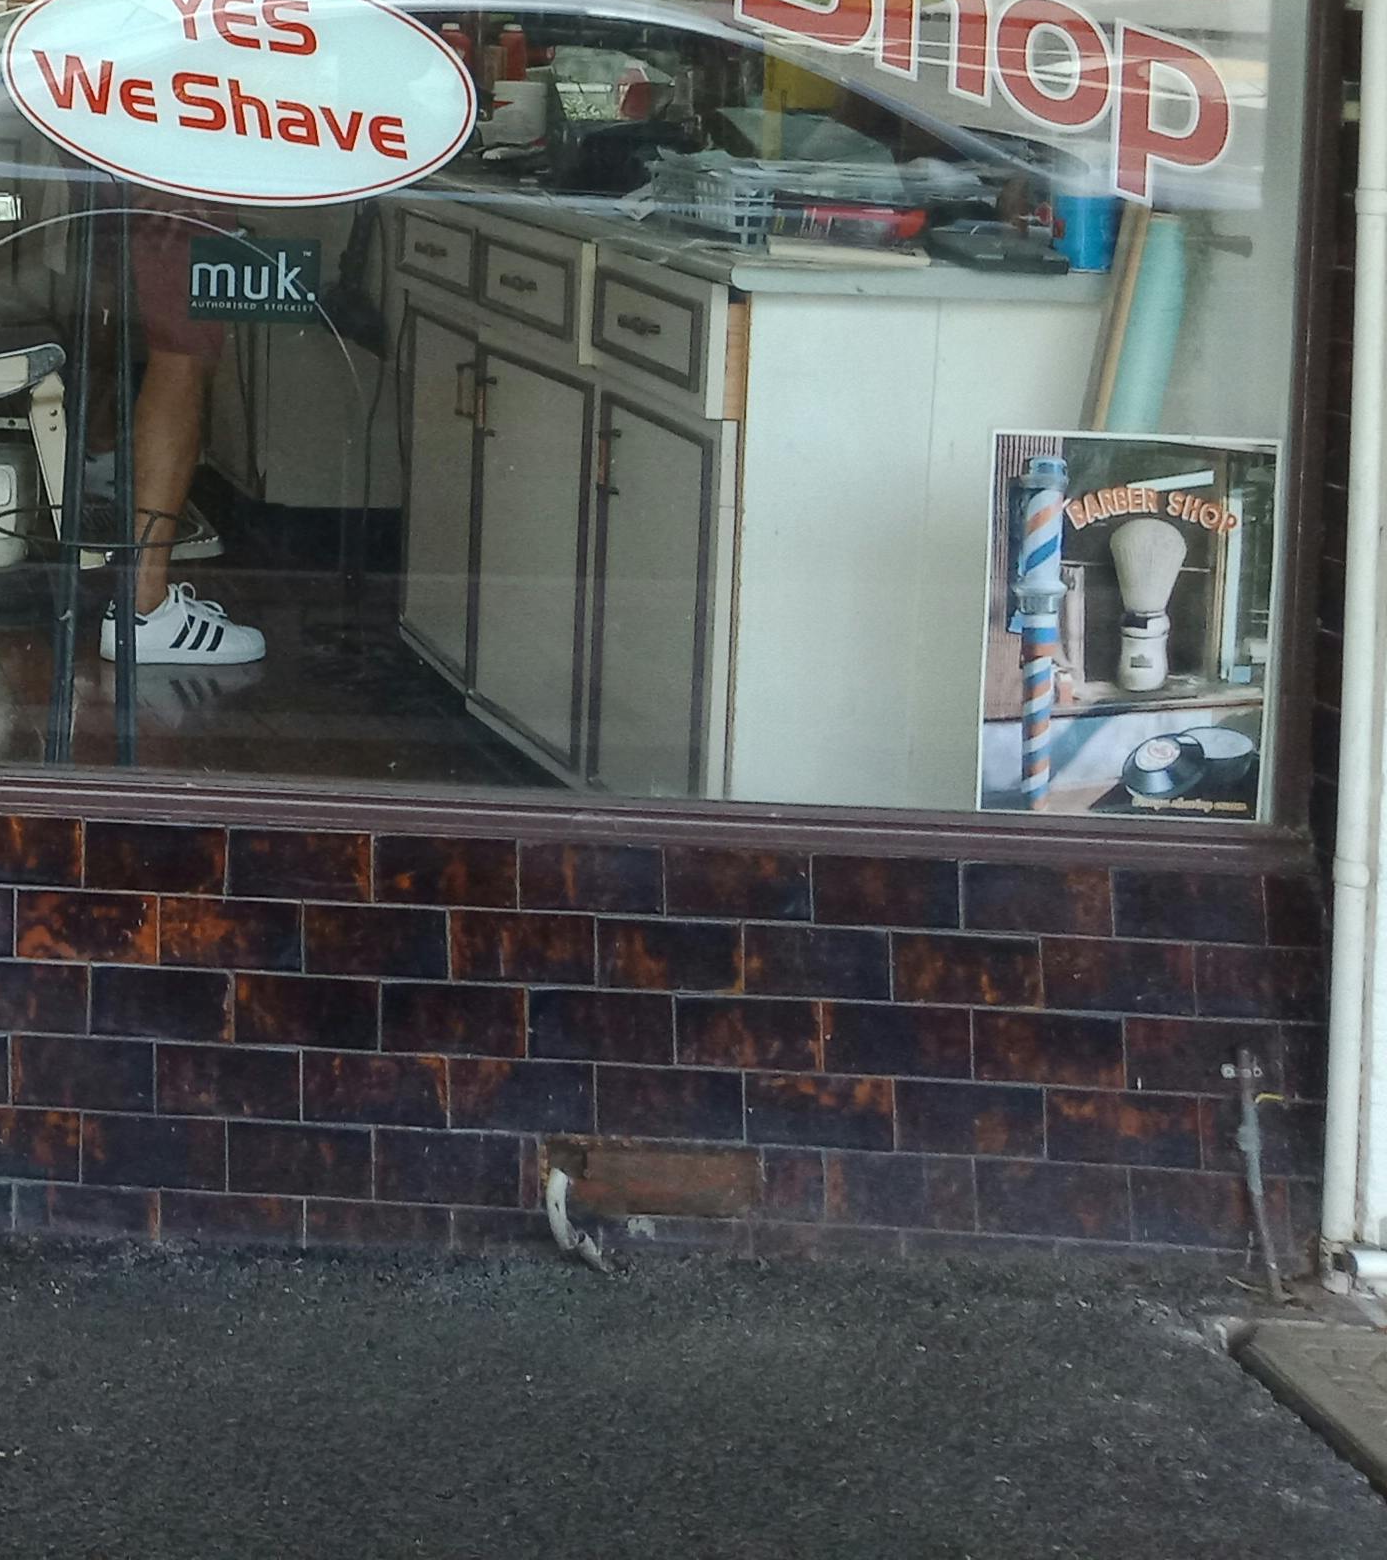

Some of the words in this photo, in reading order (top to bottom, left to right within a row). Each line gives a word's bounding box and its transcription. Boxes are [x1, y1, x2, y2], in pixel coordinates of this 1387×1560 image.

[31, 49, 159, 124] We
[171, 71, 409, 161] Shave
[190, 300, 258, 311] AUTHORISED
[264, 303, 314, 313] STOCKIST
[1067, 486, 1159, 531] BARBER
[1166, 490, 1238, 535] SHOP
